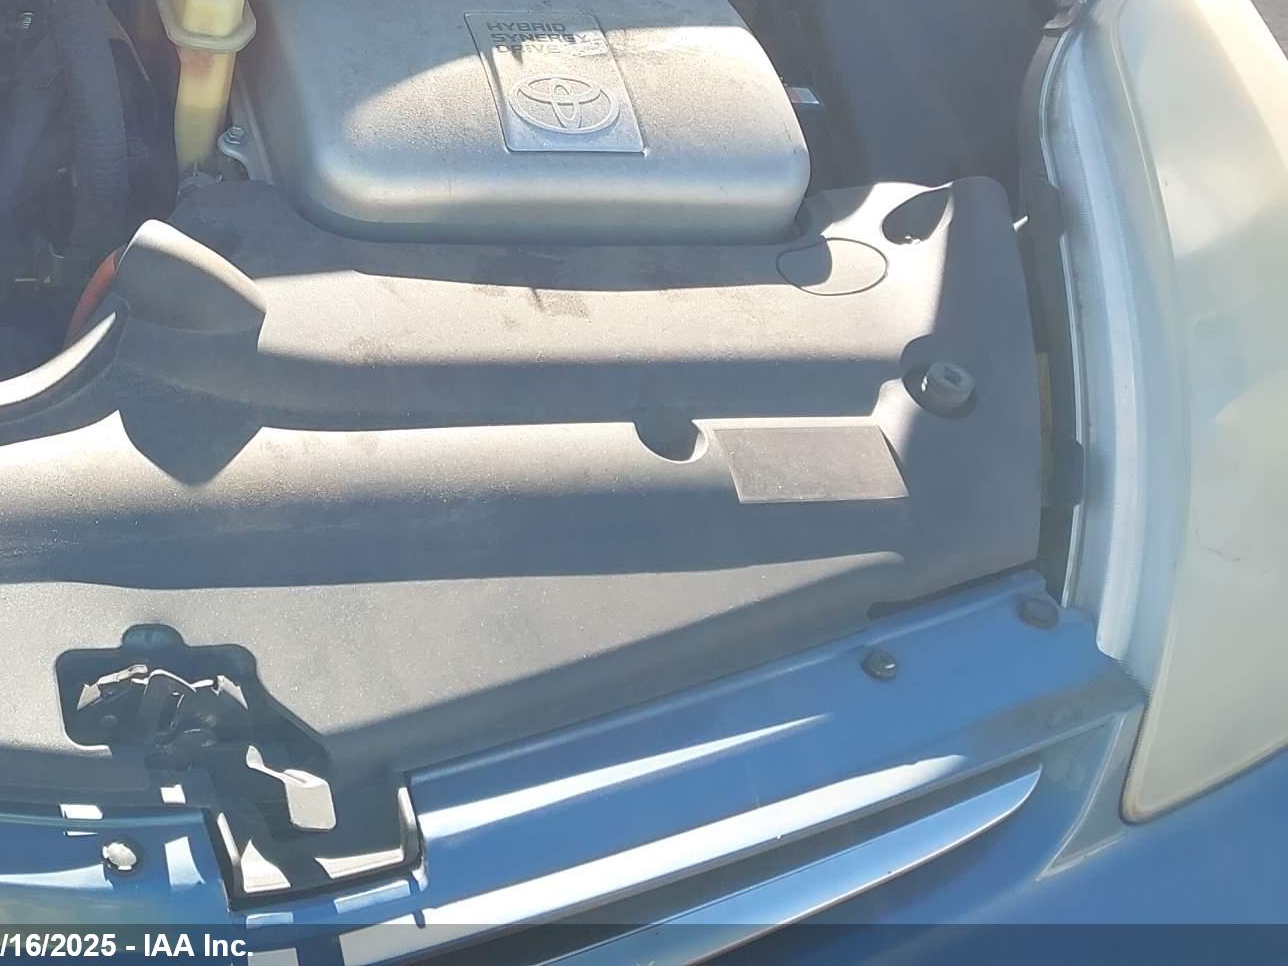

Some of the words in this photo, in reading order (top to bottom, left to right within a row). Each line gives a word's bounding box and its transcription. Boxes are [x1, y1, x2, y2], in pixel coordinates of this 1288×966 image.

[486, 22, 566, 32] HYBRID
[490, 34, 588, 43] SYNERGY
[496, 44, 561, 54] DRIVE
